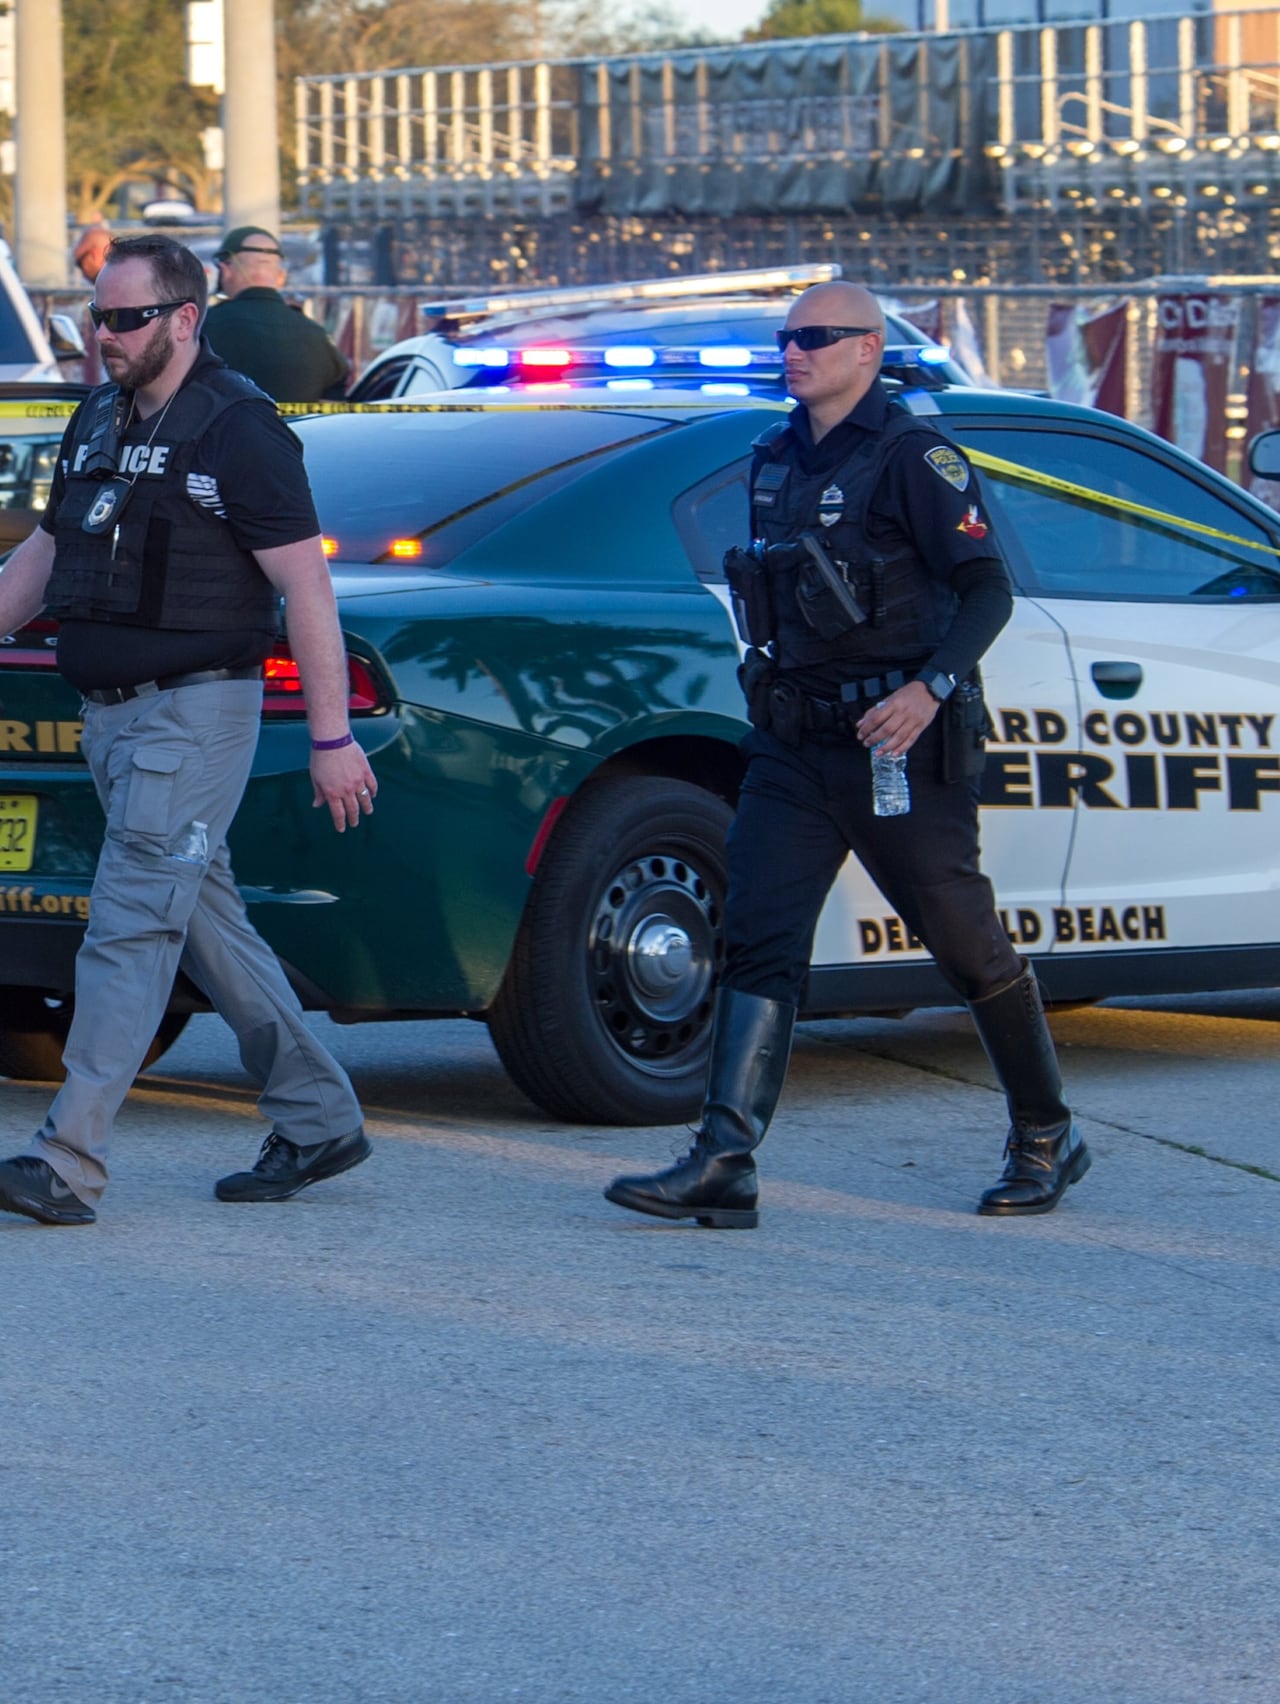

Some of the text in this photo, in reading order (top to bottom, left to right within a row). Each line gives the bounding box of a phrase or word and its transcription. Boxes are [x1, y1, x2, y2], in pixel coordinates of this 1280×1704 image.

[73, 444, 170, 474] PICE
[1084, 709, 1276, 749] COUNTY
[977, 749, 1280, 812] ERIFF
[1051, 904, 1168, 944] BEACH
